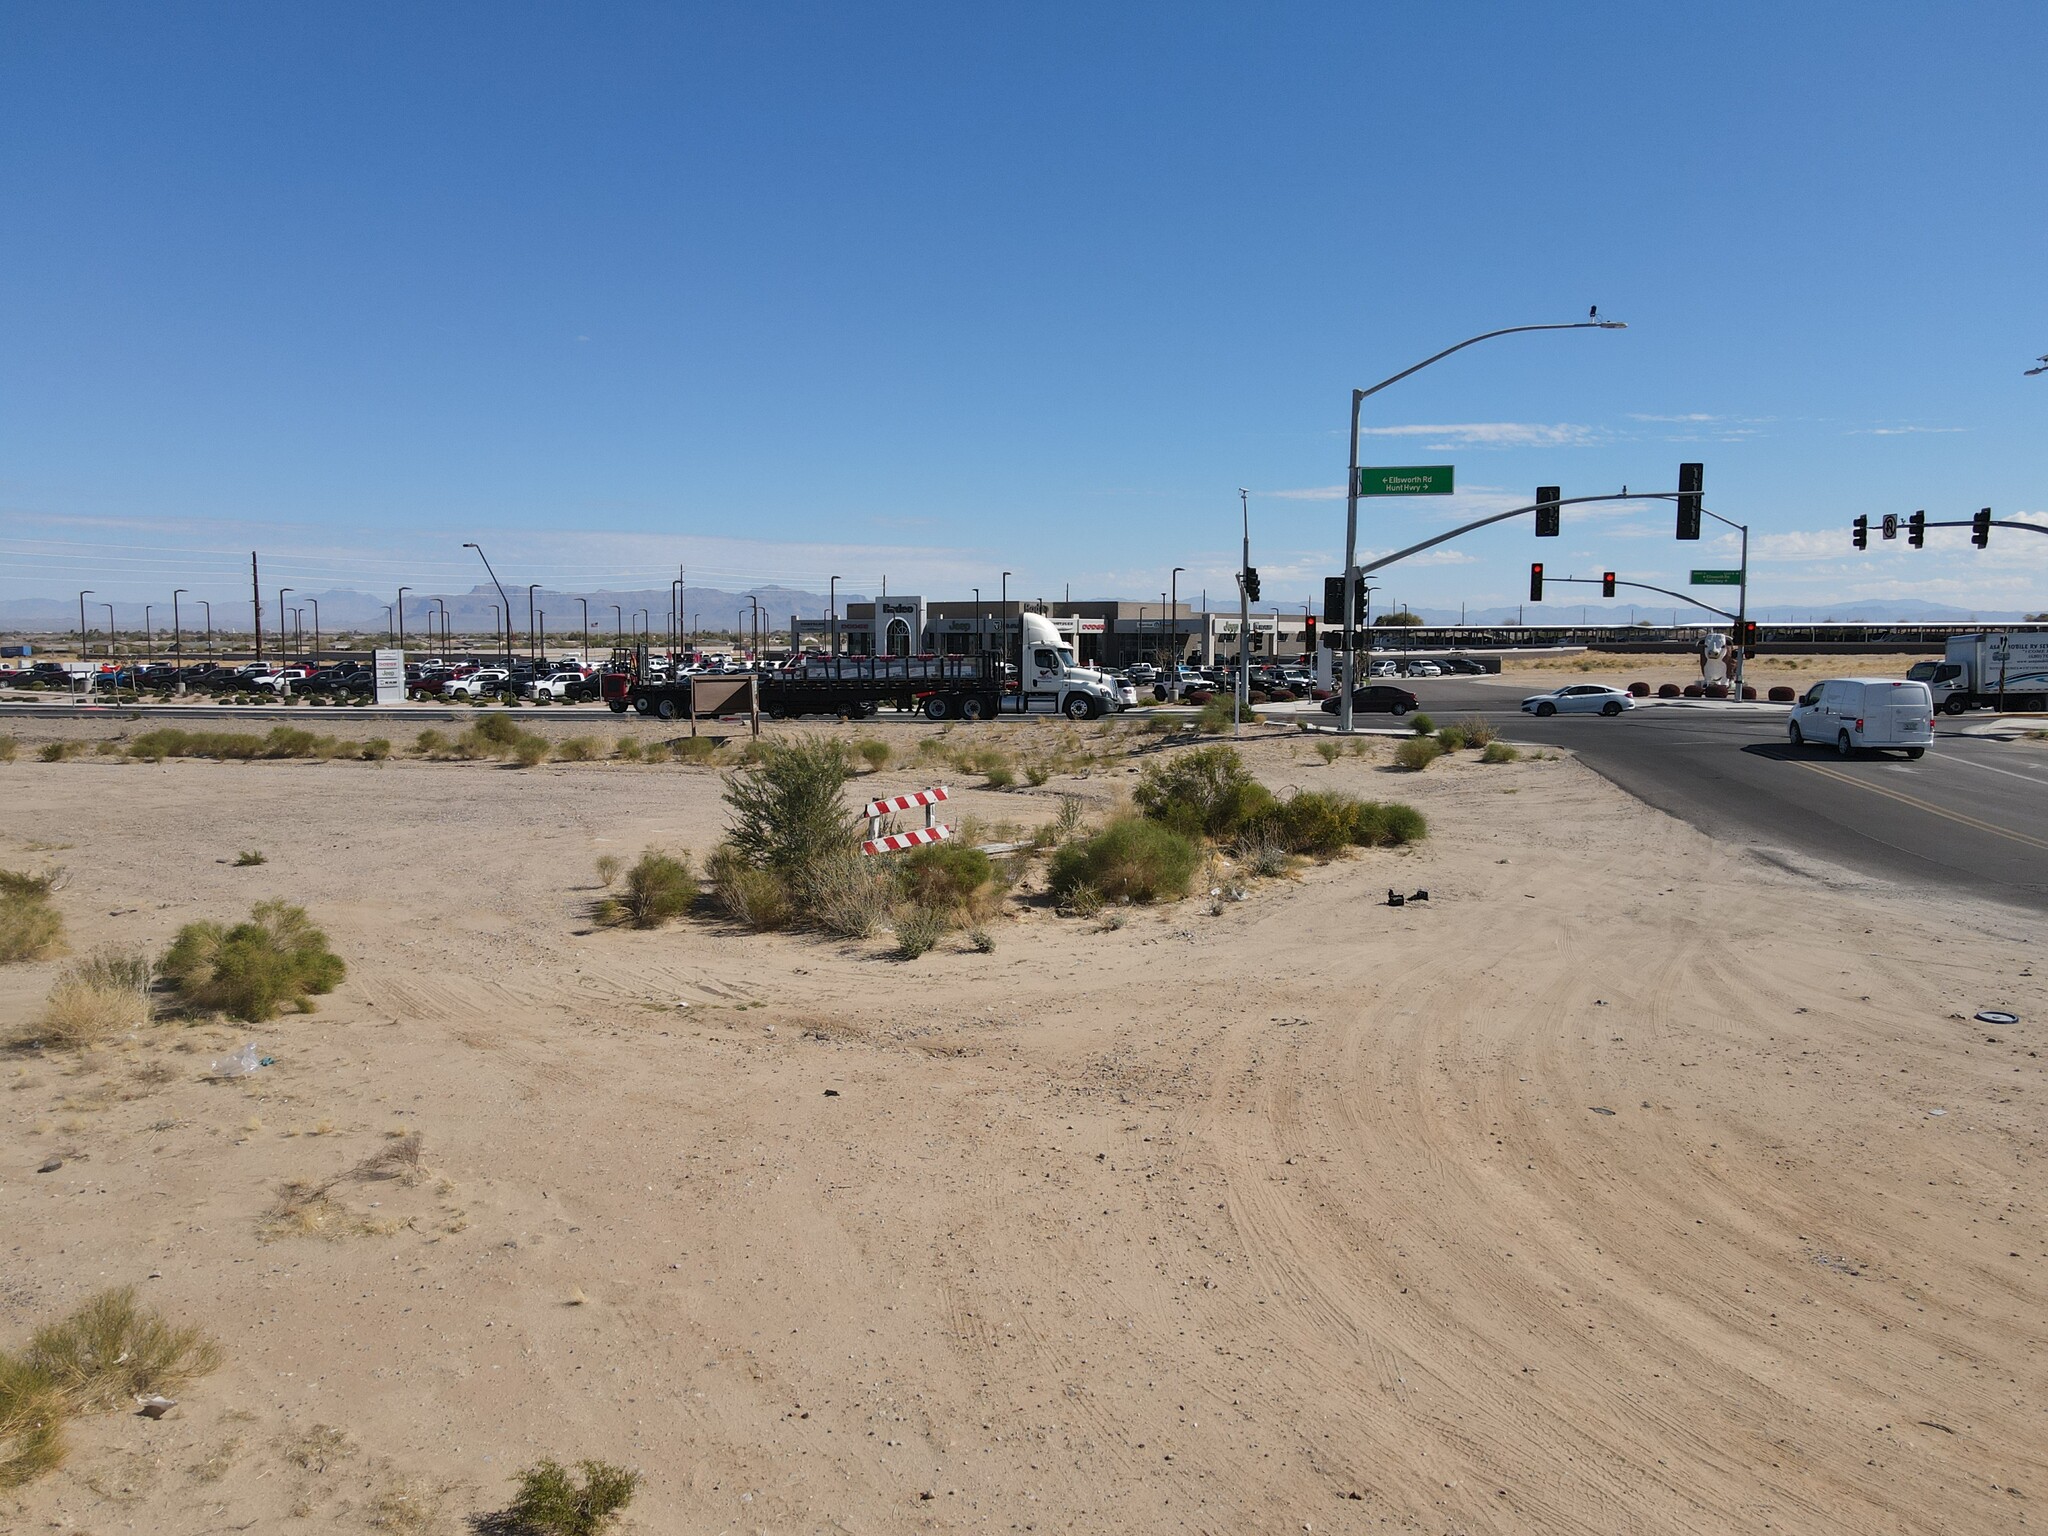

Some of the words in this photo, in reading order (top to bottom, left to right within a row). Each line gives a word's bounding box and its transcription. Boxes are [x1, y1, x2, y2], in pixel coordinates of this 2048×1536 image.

[1388, 476, 1422, 484] Ellsworth
[1403, 484, 1421, 492] Hwy
[882, 603, 914, 613] Rodeo
[1023, 602, 1049, 613] Rodo
[948, 621, 971, 631] Jeep
